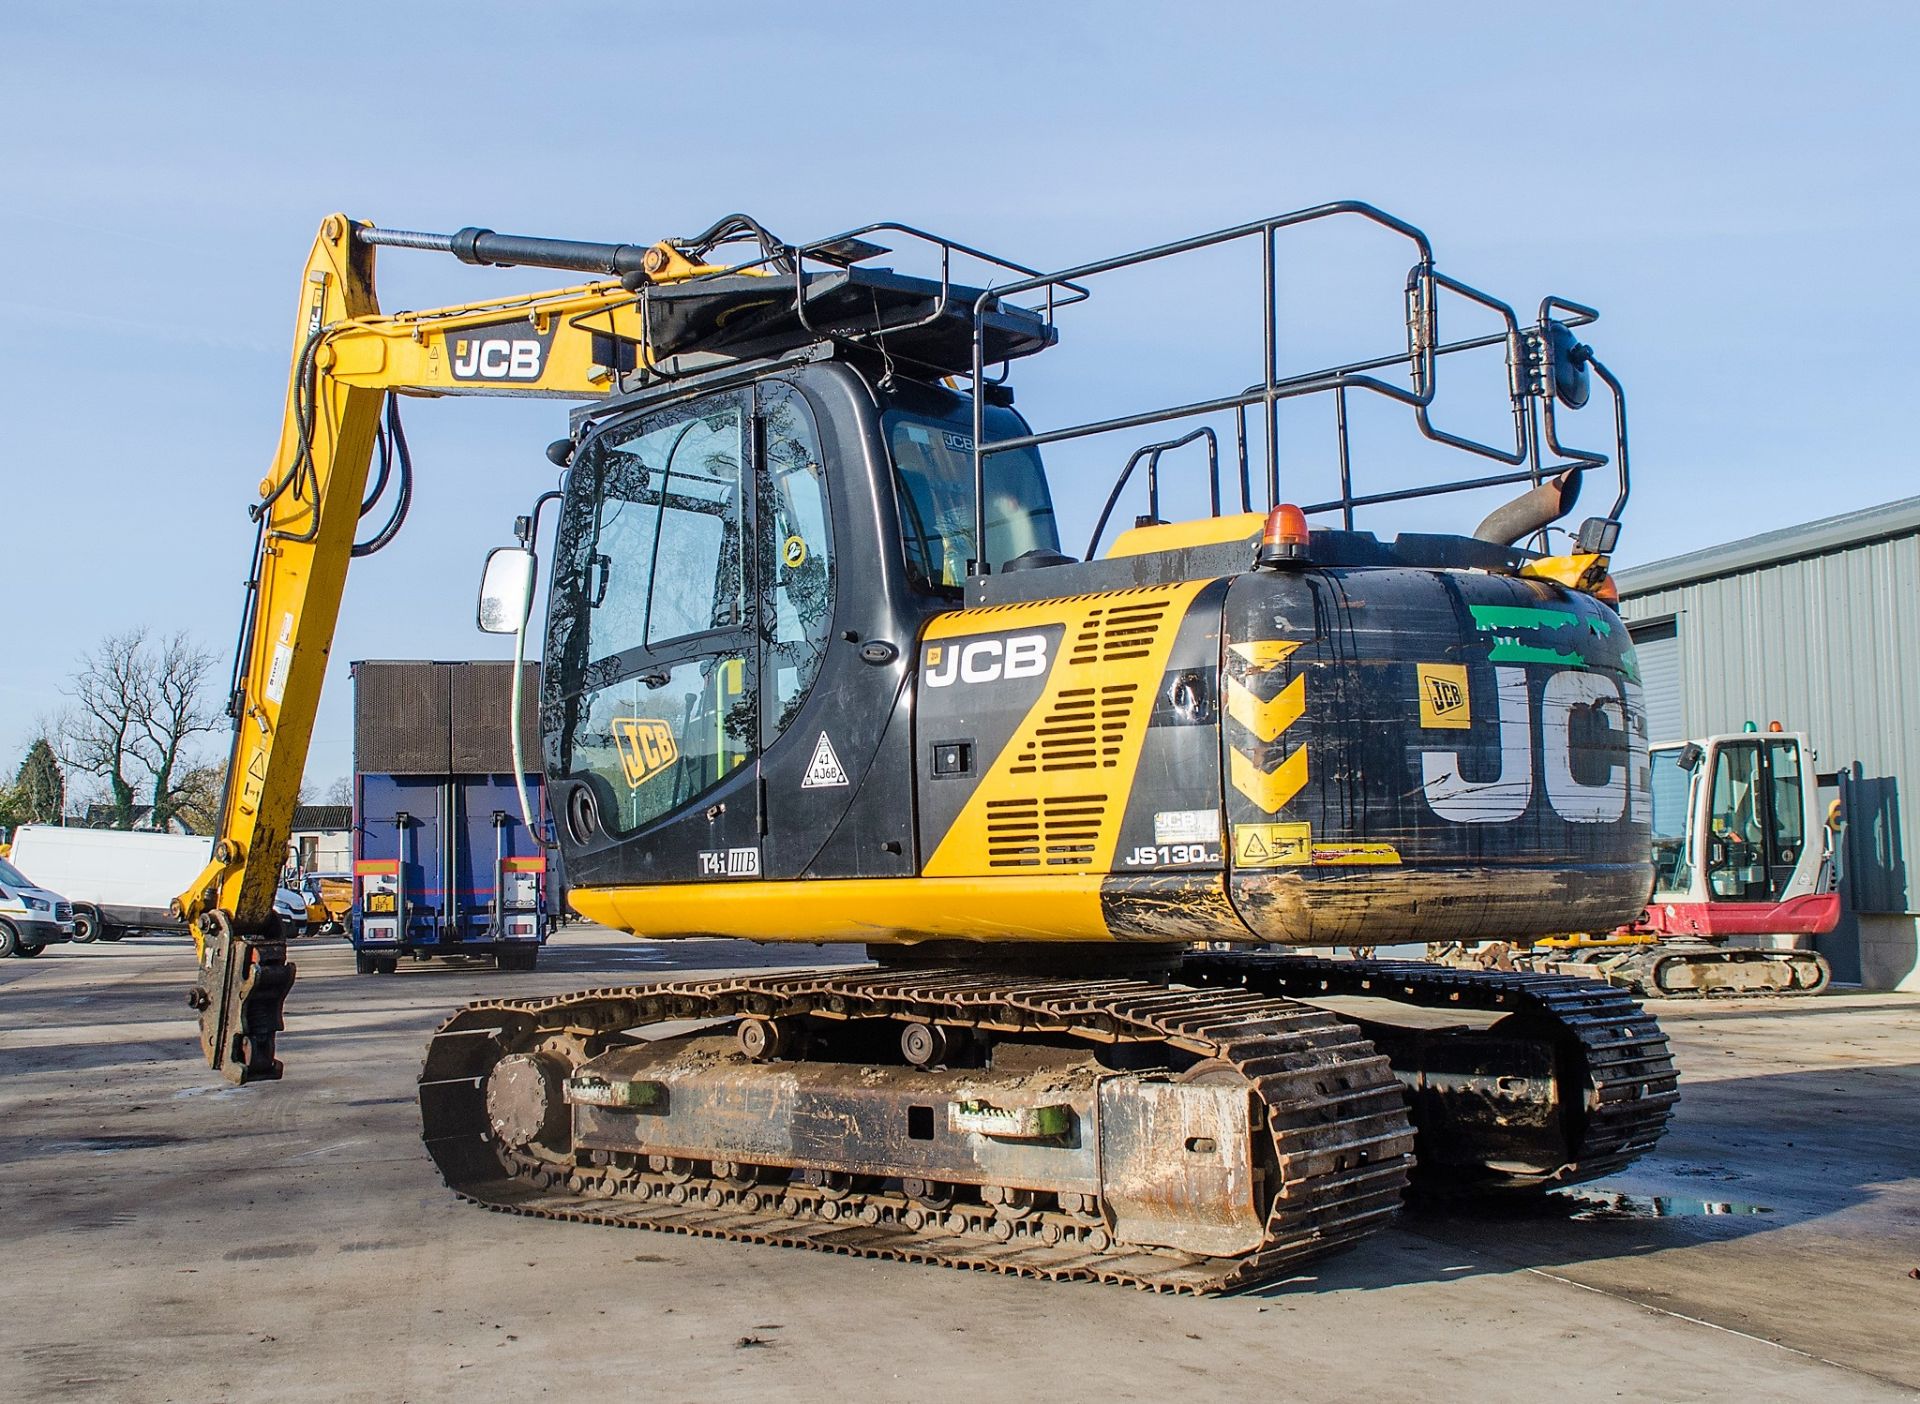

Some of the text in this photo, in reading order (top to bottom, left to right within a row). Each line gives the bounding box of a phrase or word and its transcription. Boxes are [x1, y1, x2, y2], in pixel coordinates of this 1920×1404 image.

[455, 340, 540, 378] JCB
[945, 434, 974, 450] JCB
[926, 635, 1047, 688] JCB
[1432, 681, 1461, 711] JCB
[624, 725, 673, 778] JCB
[819, 753, 829, 765] 41
[1126, 845, 1205, 865] JS130
